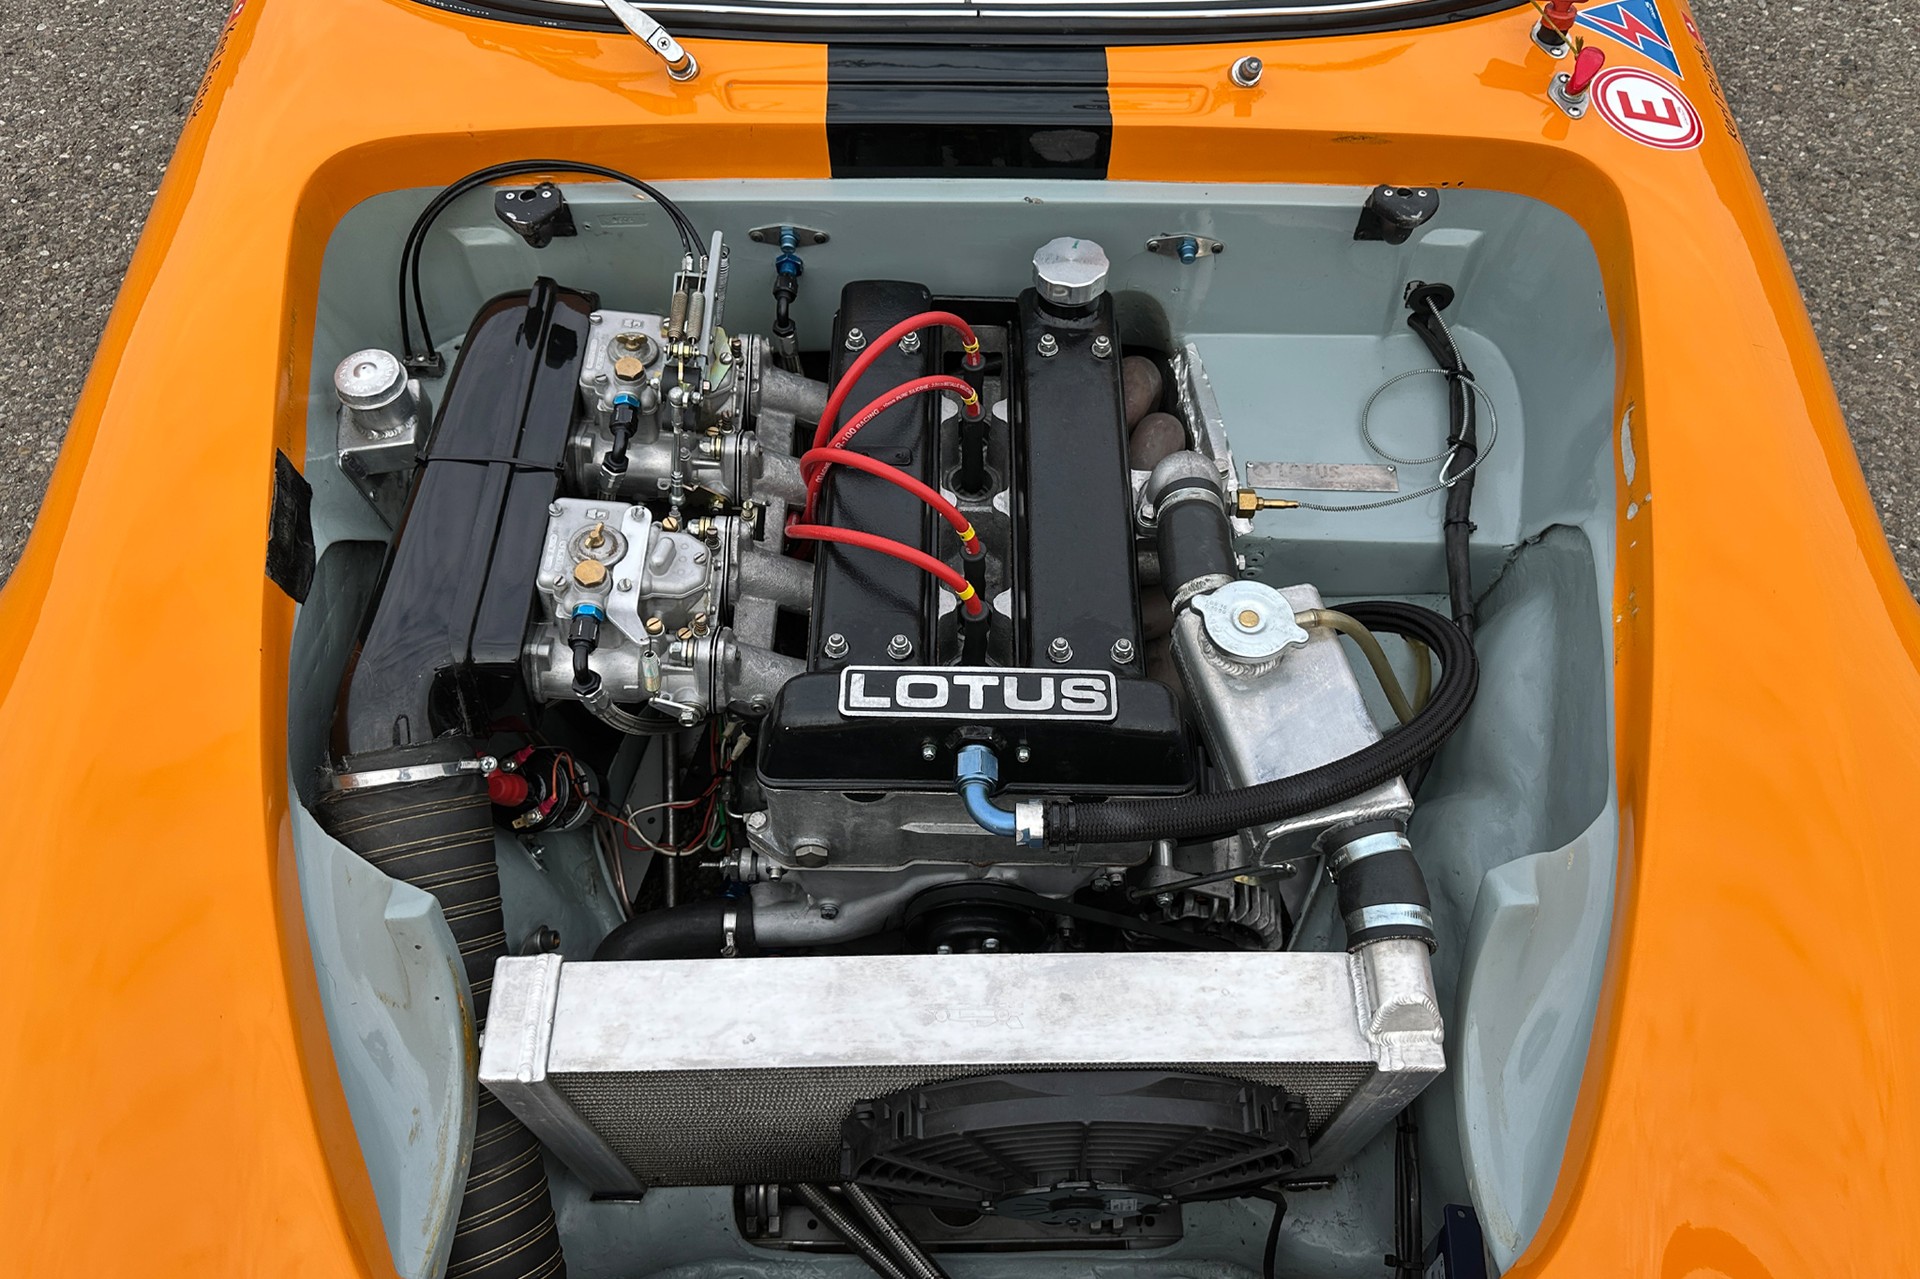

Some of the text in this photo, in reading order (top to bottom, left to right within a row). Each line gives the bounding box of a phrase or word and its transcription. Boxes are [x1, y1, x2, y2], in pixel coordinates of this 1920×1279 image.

[1616, 90, 1683, 128] E
[835, 427, 857, 450] R-100
[856, 408, 880, 429] RACING
[849, 673, 1107, 712] LOTUS
